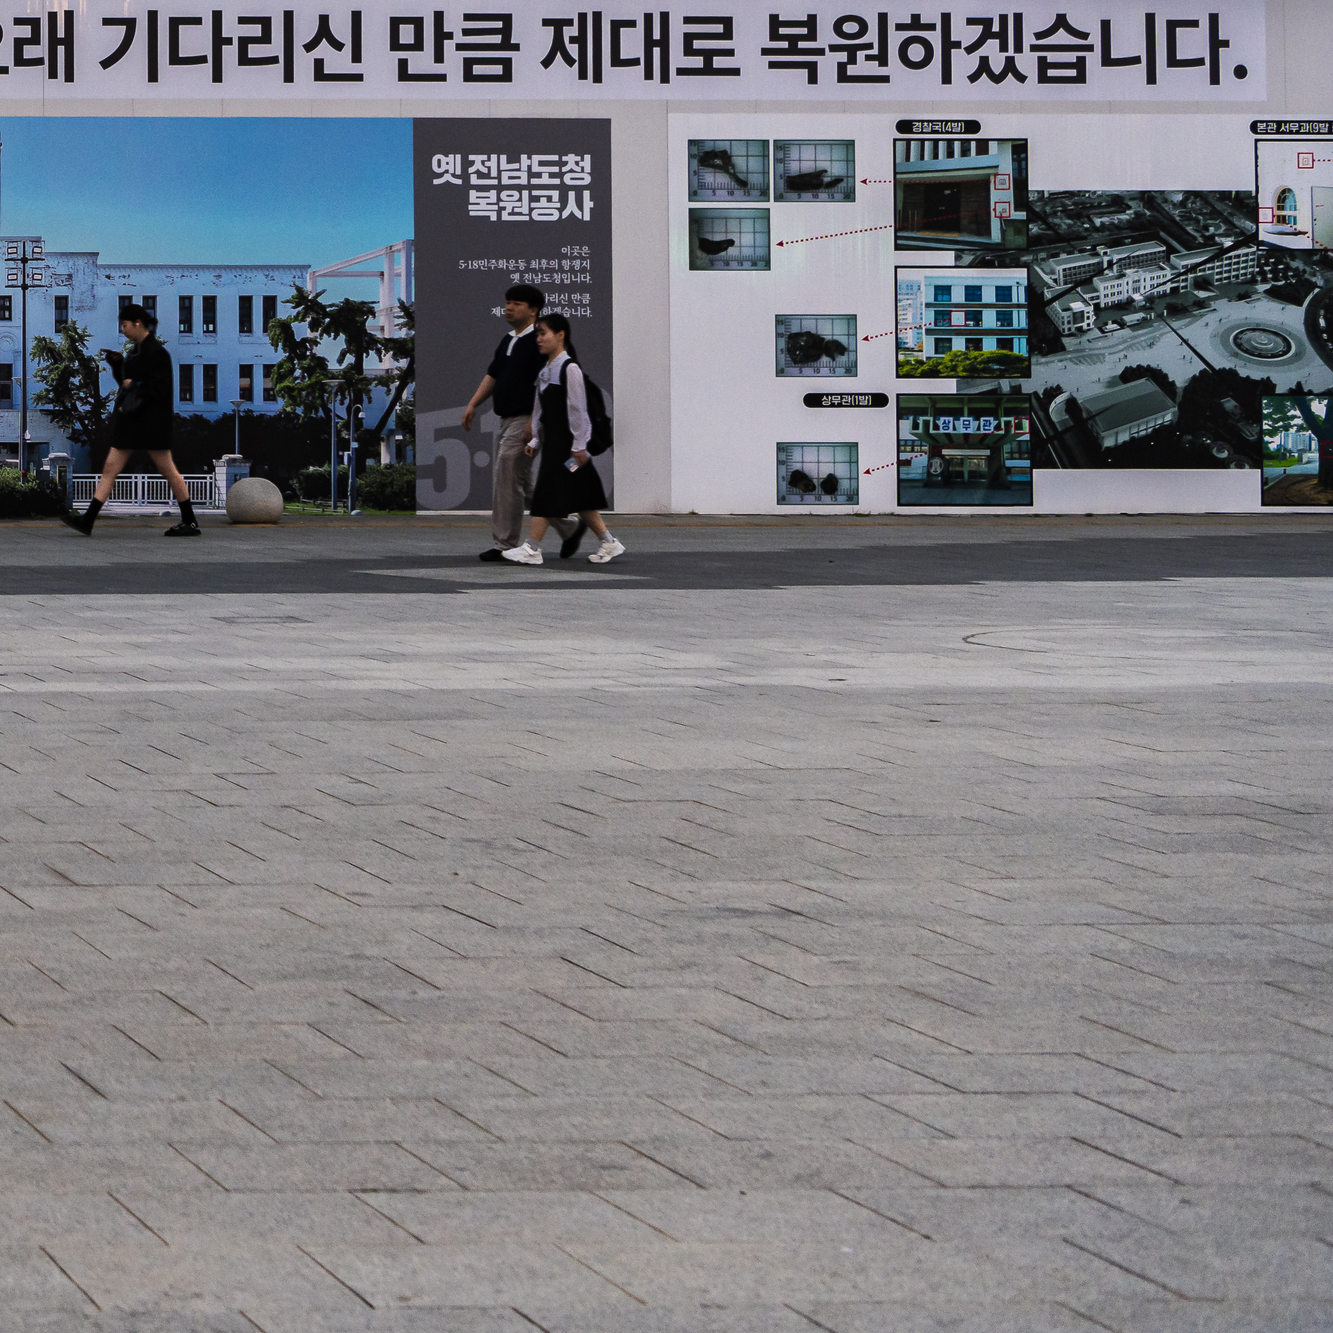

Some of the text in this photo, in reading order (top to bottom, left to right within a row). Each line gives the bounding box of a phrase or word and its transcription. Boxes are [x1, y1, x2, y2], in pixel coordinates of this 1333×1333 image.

[99, 9, 364, 84] 기다리신
[389, 10, 521, 83] 만큼
[540, 10, 741, 85] 제대로
[760, 11, 1248, 86] 복원하겠습니다.
[912, 121, 965, 133] 경찰국(4발)
[1257, 122, 1277, 133] 본관
[431, 153, 592, 185] 옛 전남도청
[468, 190, 594, 221] 복원공사
[561, 245, 591, 258] 이곳은
[458, 258, 590, 271] 5·18민주화운동 최후의 항쟁지
[510, 272, 593, 284] 옛 전남도청입니다.
[571, 292, 591, 305] 만큼
[941, 419, 993, 432] 상무관
